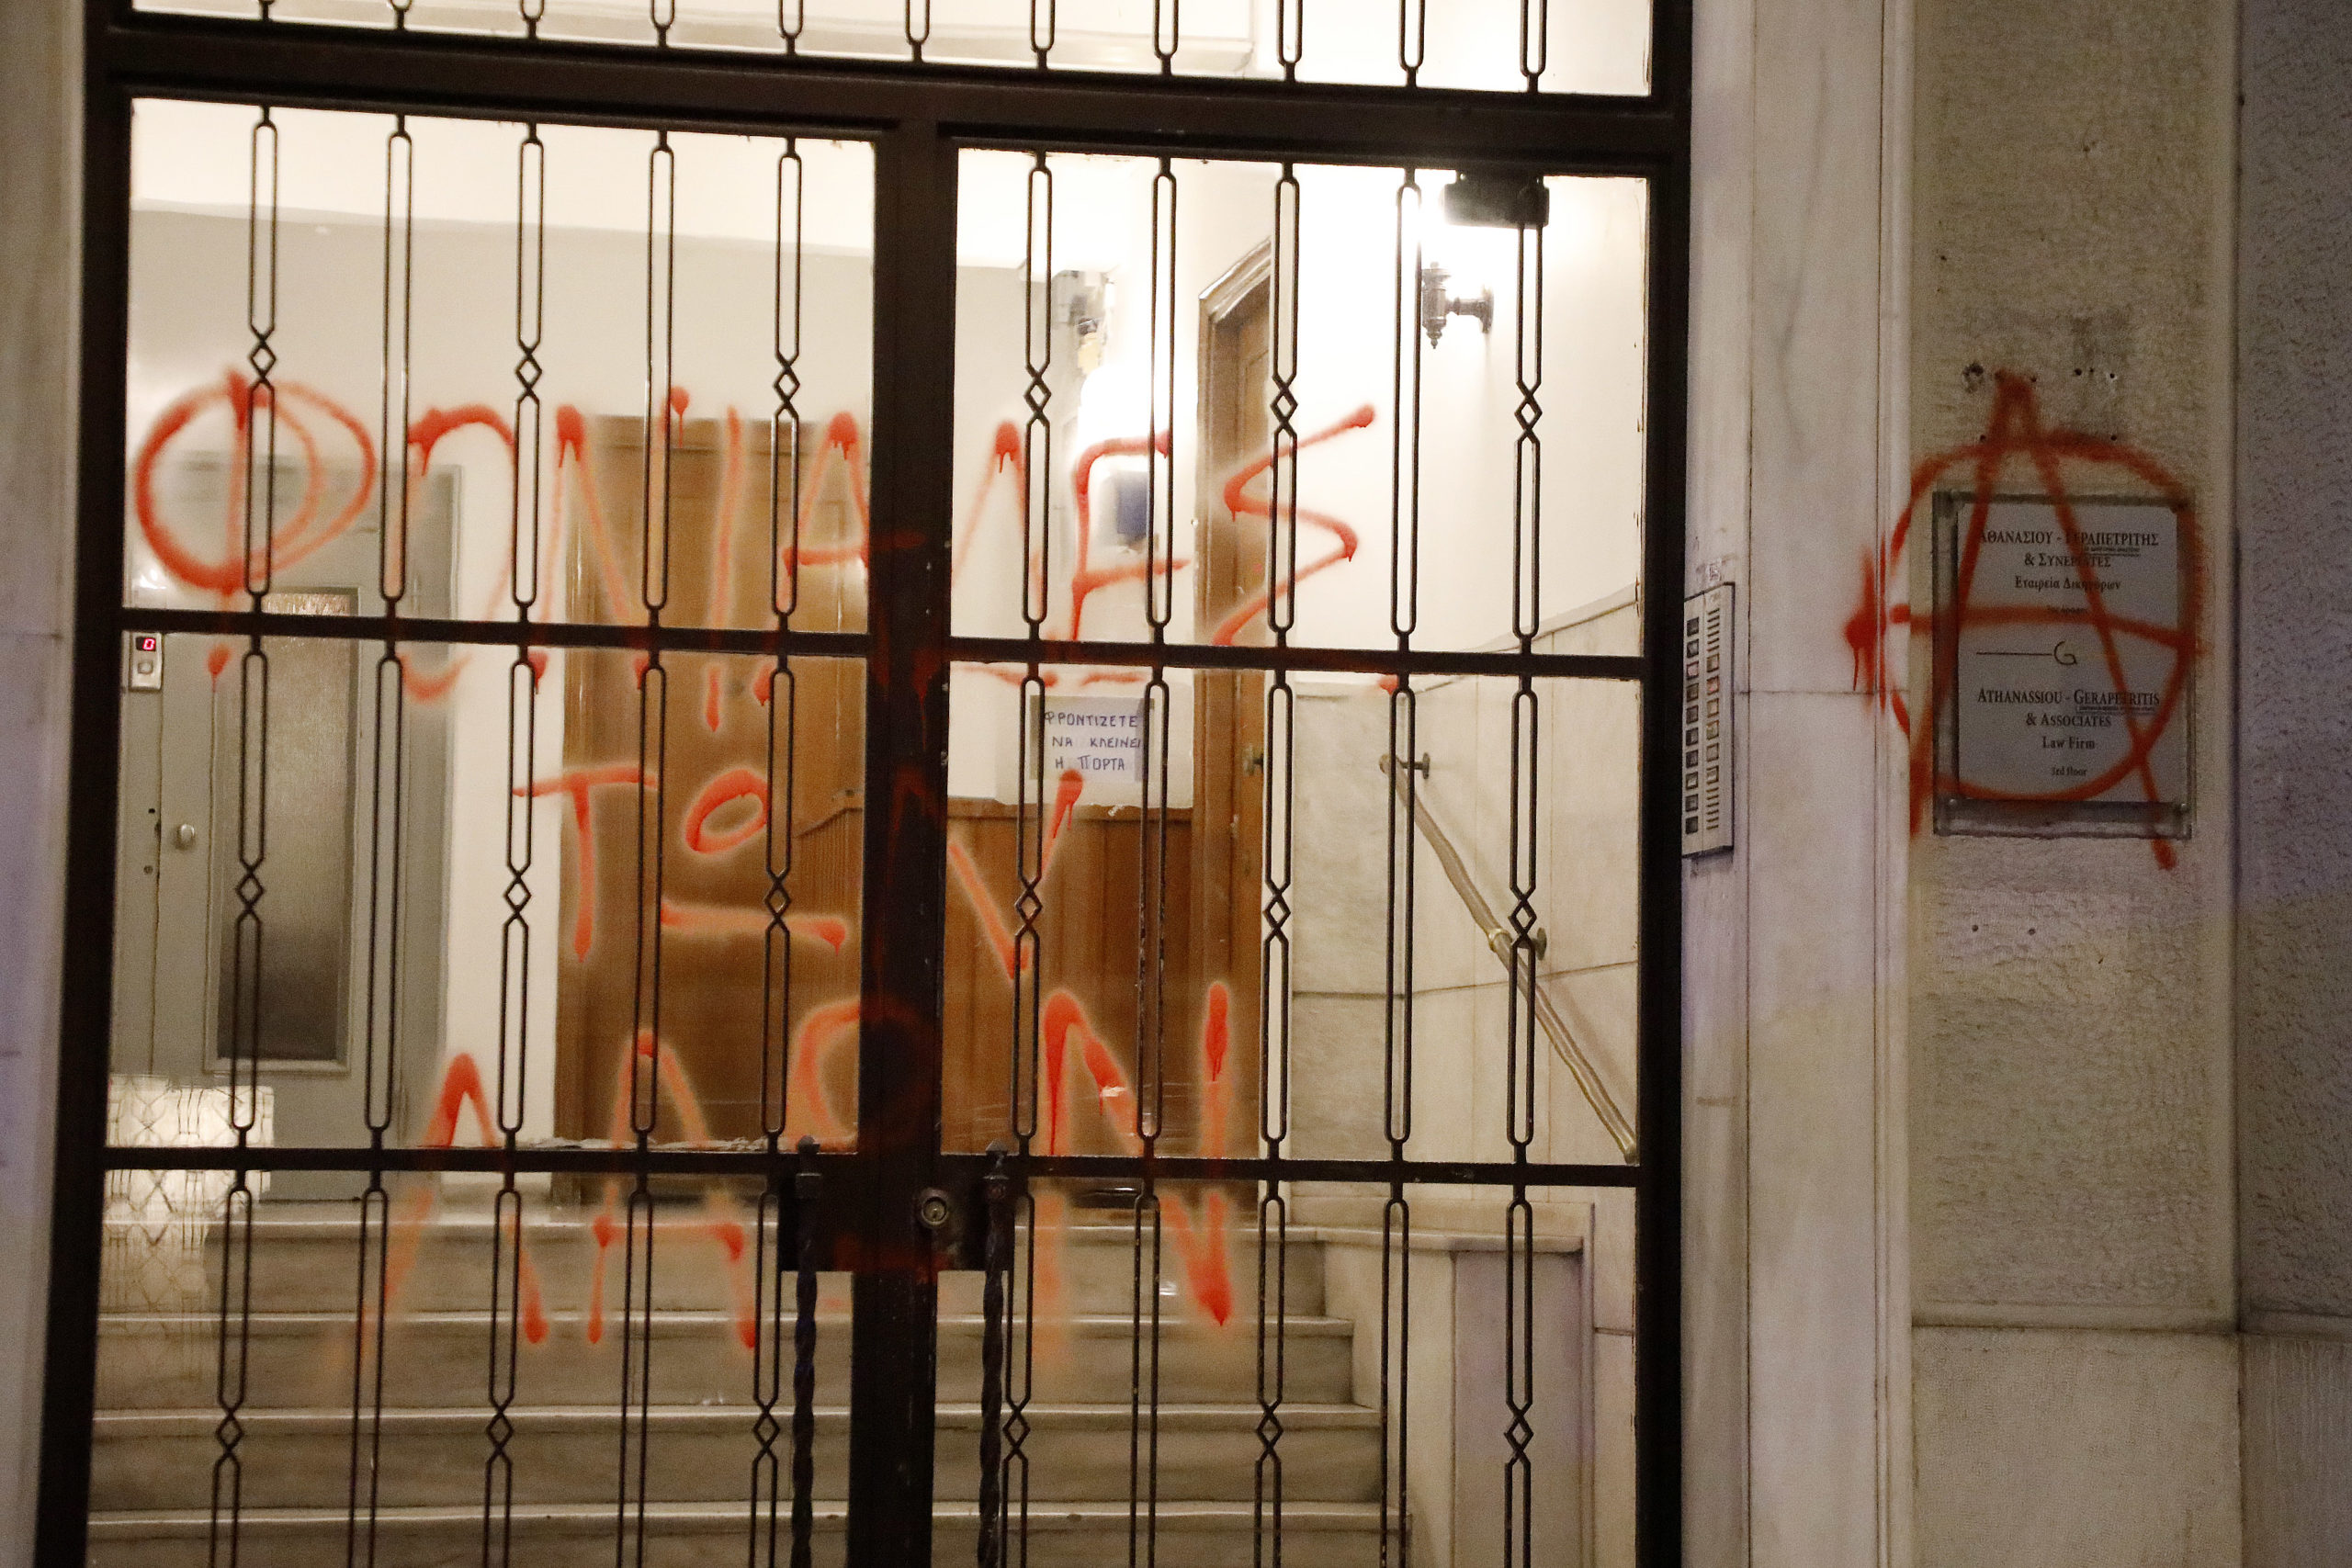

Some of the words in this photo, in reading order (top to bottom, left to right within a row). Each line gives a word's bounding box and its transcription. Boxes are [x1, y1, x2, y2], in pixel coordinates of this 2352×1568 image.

[2024, 553, 2034, 567] &
[2038, 553, 2112, 568] ΣΥΝΕΡΤΕΣ
[2015, 575, 2061, 592] Εταιρεία
[1977, 688, 2063, 705] ATHANASSIOU
[2025, 713, 2036, 727] &
[2041, 714, 2112, 728] ASSOCIATES
[1052, 737, 1073, 748] ΝΑ
[2041, 736, 2064, 750] Law
[2068, 737, 2096, 750] Firm
[1078, 754, 1125, 771] ΠΟΡΤΑ
